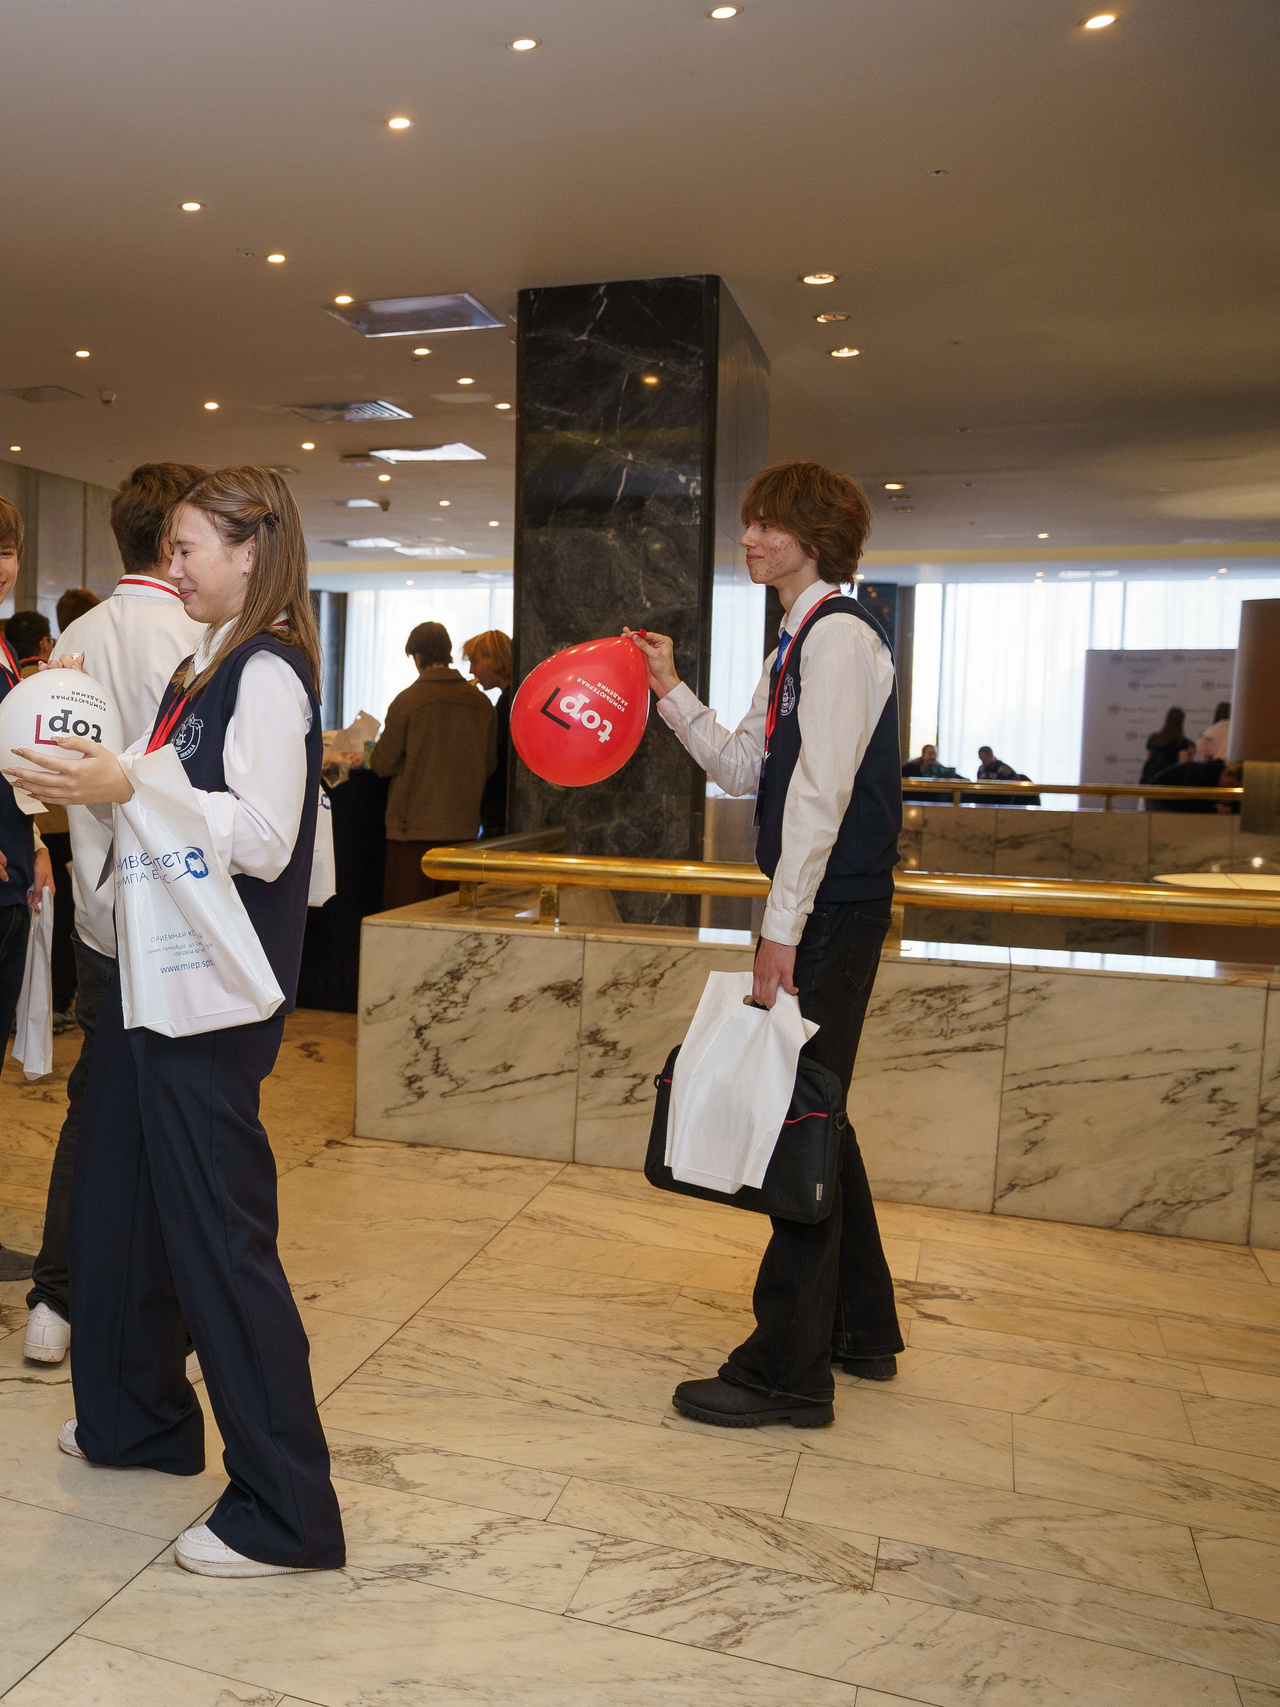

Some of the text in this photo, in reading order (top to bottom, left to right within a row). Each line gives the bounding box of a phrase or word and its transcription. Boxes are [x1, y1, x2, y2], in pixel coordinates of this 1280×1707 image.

[50, 694, 107, 712] КОМПЬЮТЕРНАЯ
[71, 690, 107, 706] АКАДЕМИЯ
[576, 677, 625, 713] КОМПЬЮТЕРНАЯ
[597, 681, 629, 707] АКАДЕМИЯ
[48, 708, 102, 744] top
[559, 693, 613, 744] top
